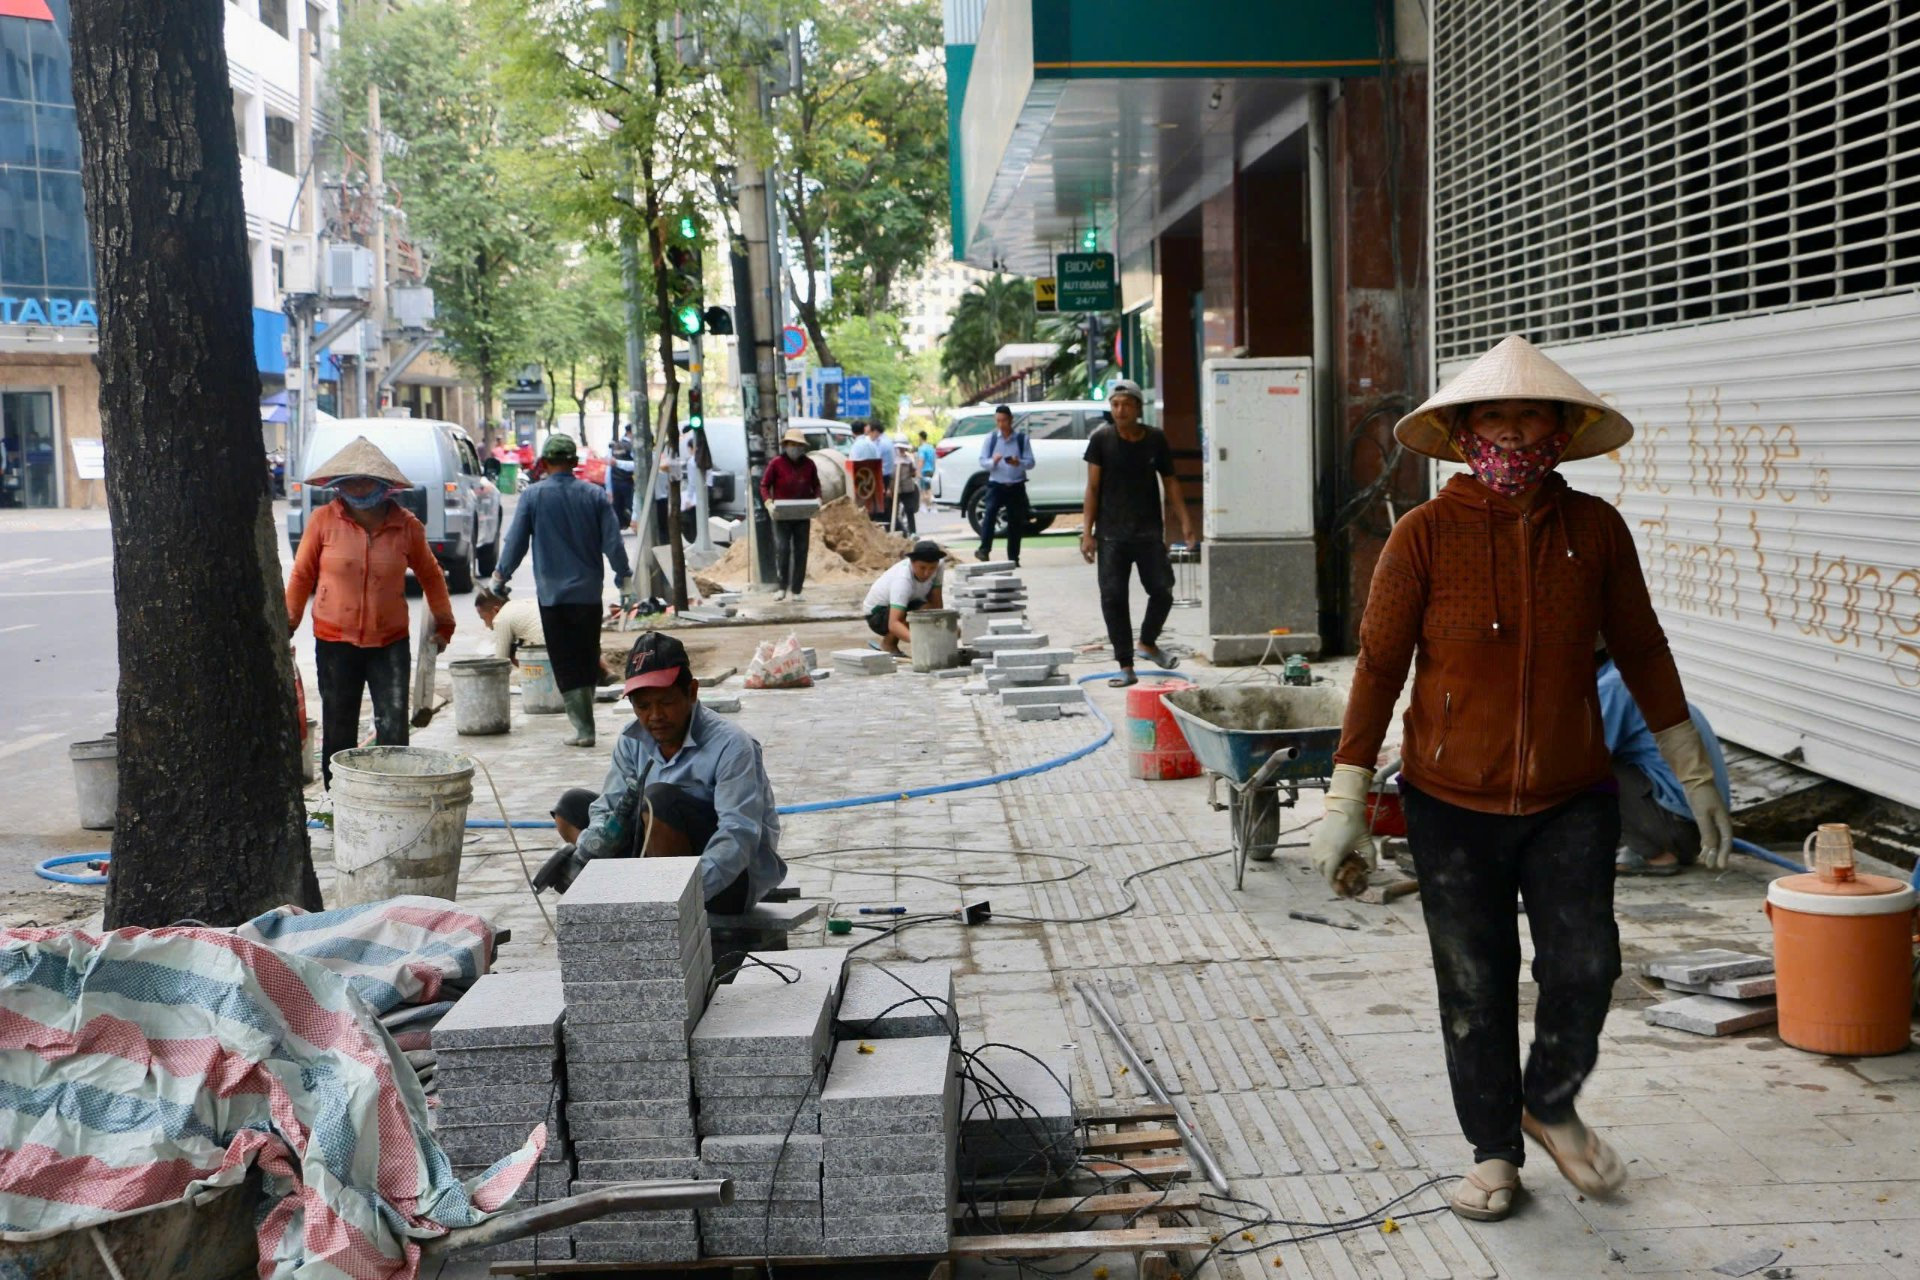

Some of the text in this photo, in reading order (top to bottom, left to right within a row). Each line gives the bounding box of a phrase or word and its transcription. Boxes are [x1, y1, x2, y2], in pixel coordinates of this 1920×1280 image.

[1065, 261, 1094, 273] BIDV
[1063, 281, 1109, 290] AUTOBANK
[1075, 297, 1097, 305] 24/7
